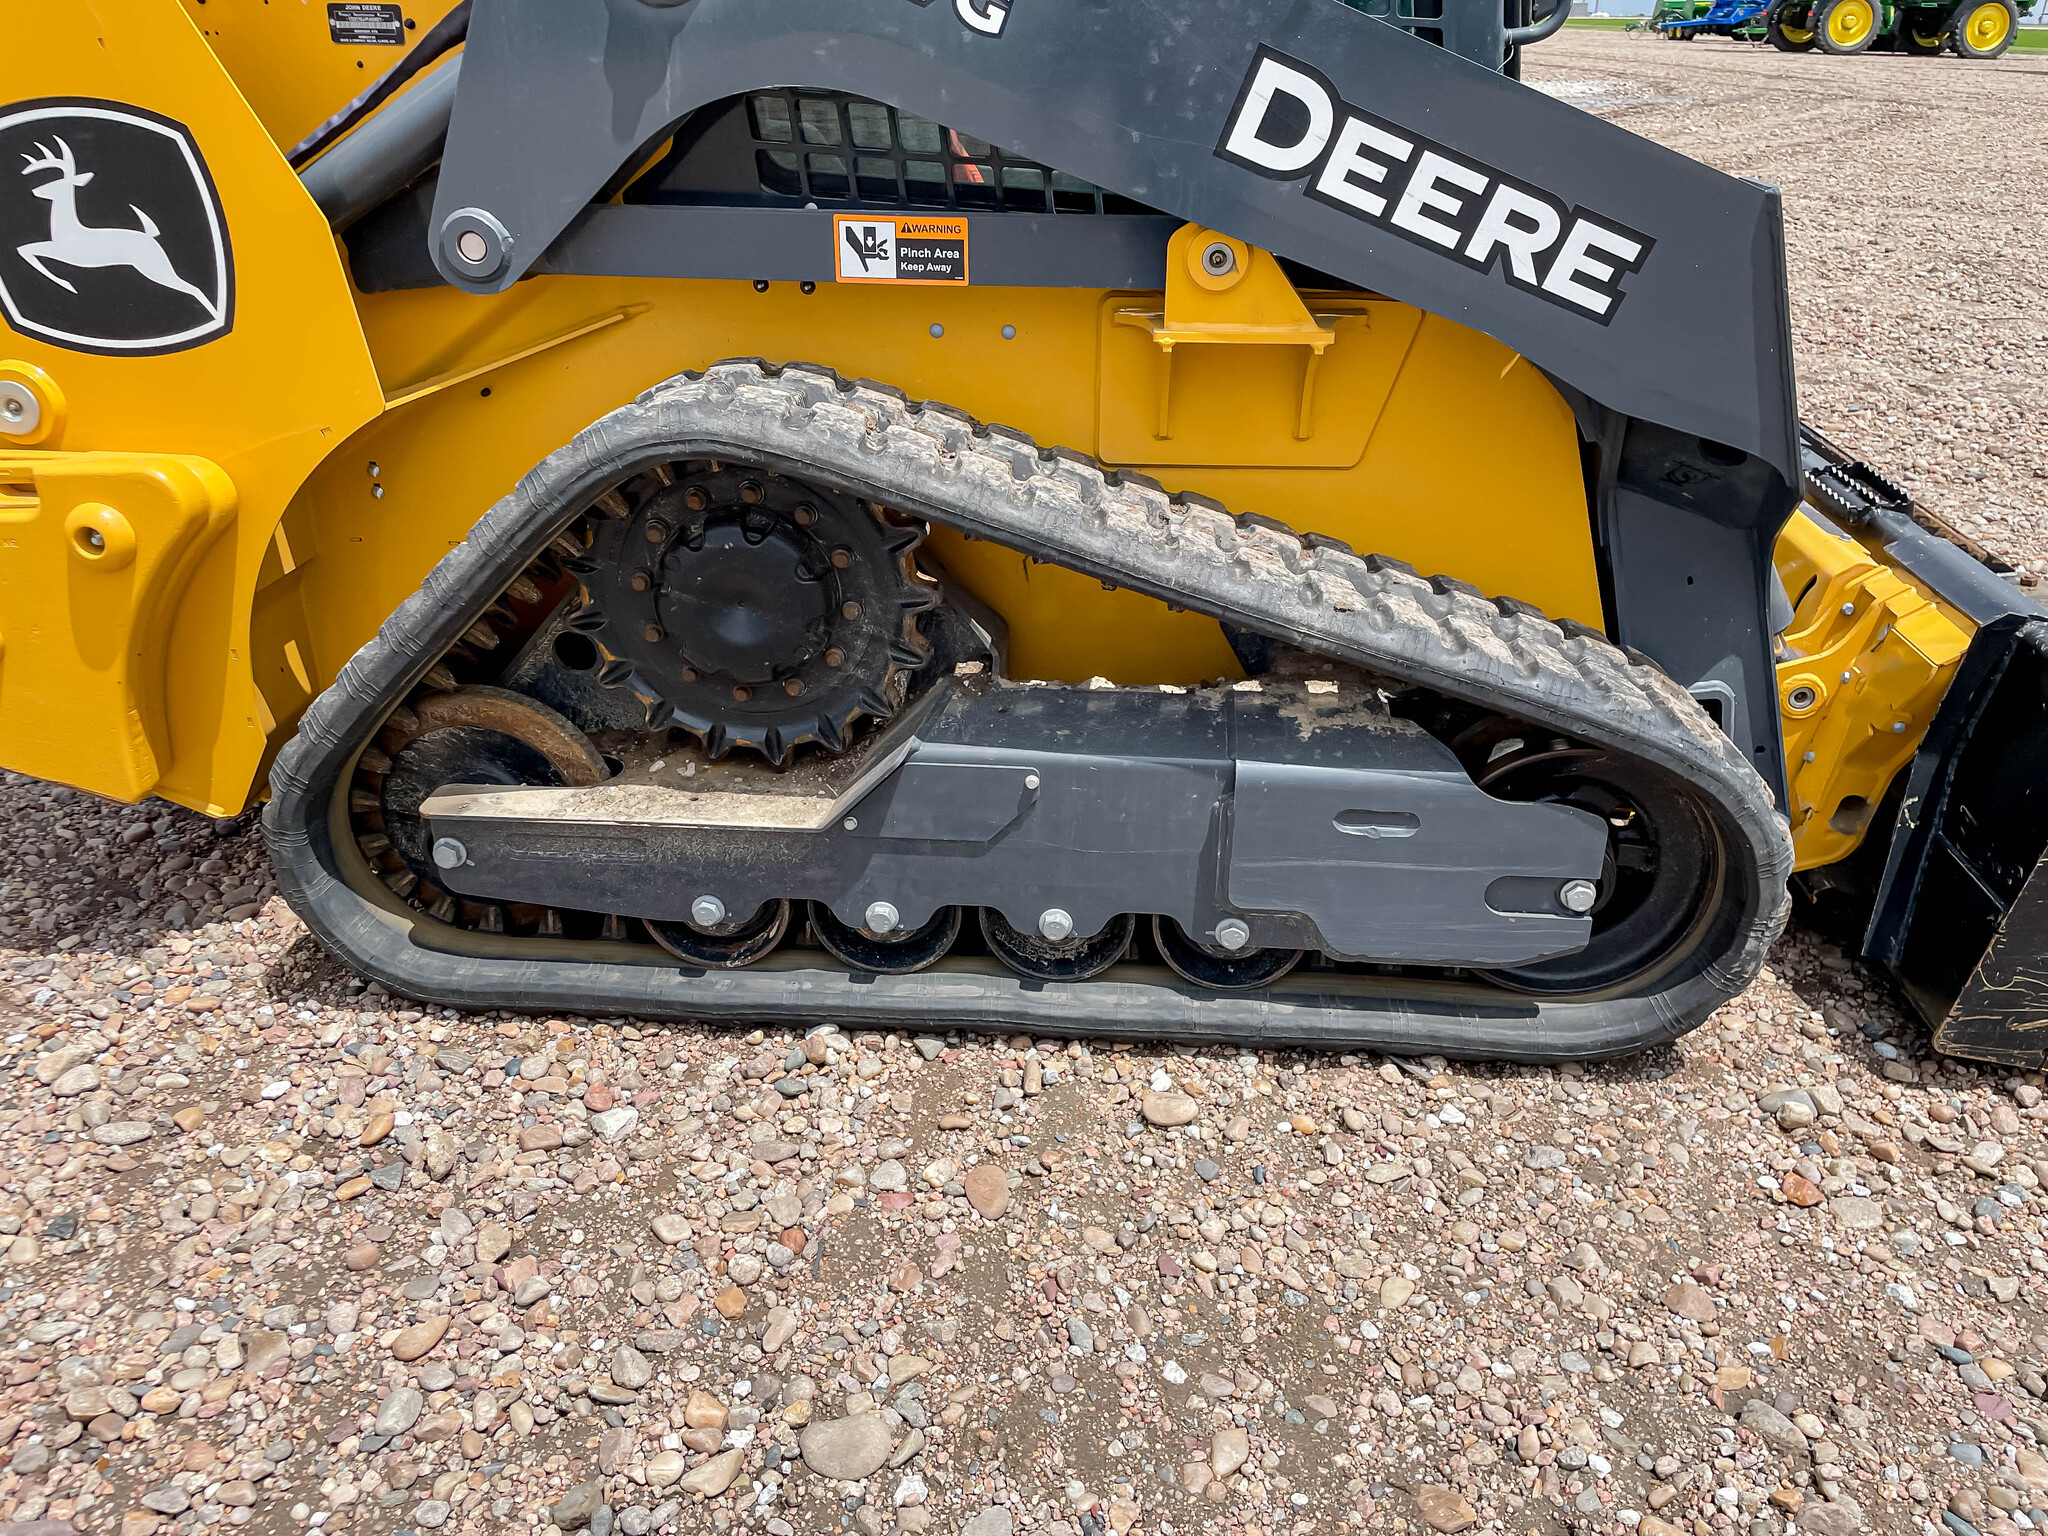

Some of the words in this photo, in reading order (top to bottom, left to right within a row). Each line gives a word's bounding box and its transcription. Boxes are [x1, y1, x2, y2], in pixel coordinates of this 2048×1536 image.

[1225, 57, 1643, 315] DEERE
[911, 225, 962, 234] WARNING
[900, 247, 931, 258] Pinch
[934, 248, 960, 259] Area
[900, 262, 924, 272] Keep
[926, 262, 952, 273] Away
